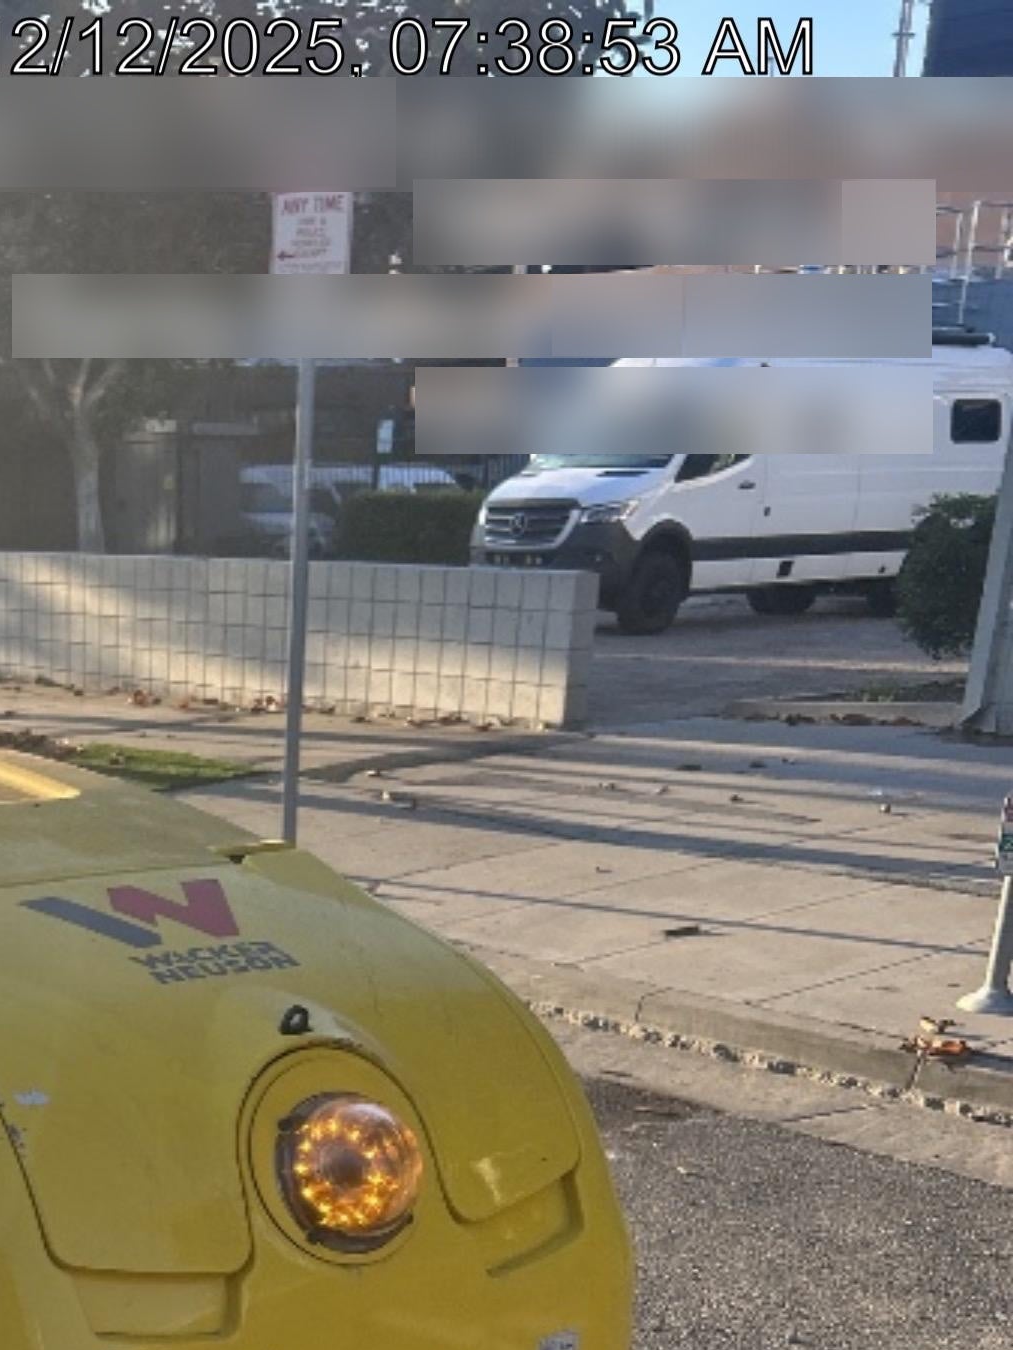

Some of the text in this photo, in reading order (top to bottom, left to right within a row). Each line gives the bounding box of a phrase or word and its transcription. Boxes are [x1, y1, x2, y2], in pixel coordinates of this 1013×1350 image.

[280, 194, 345, 215] ANY TIME
[150, 954, 301, 984] NEUSON
